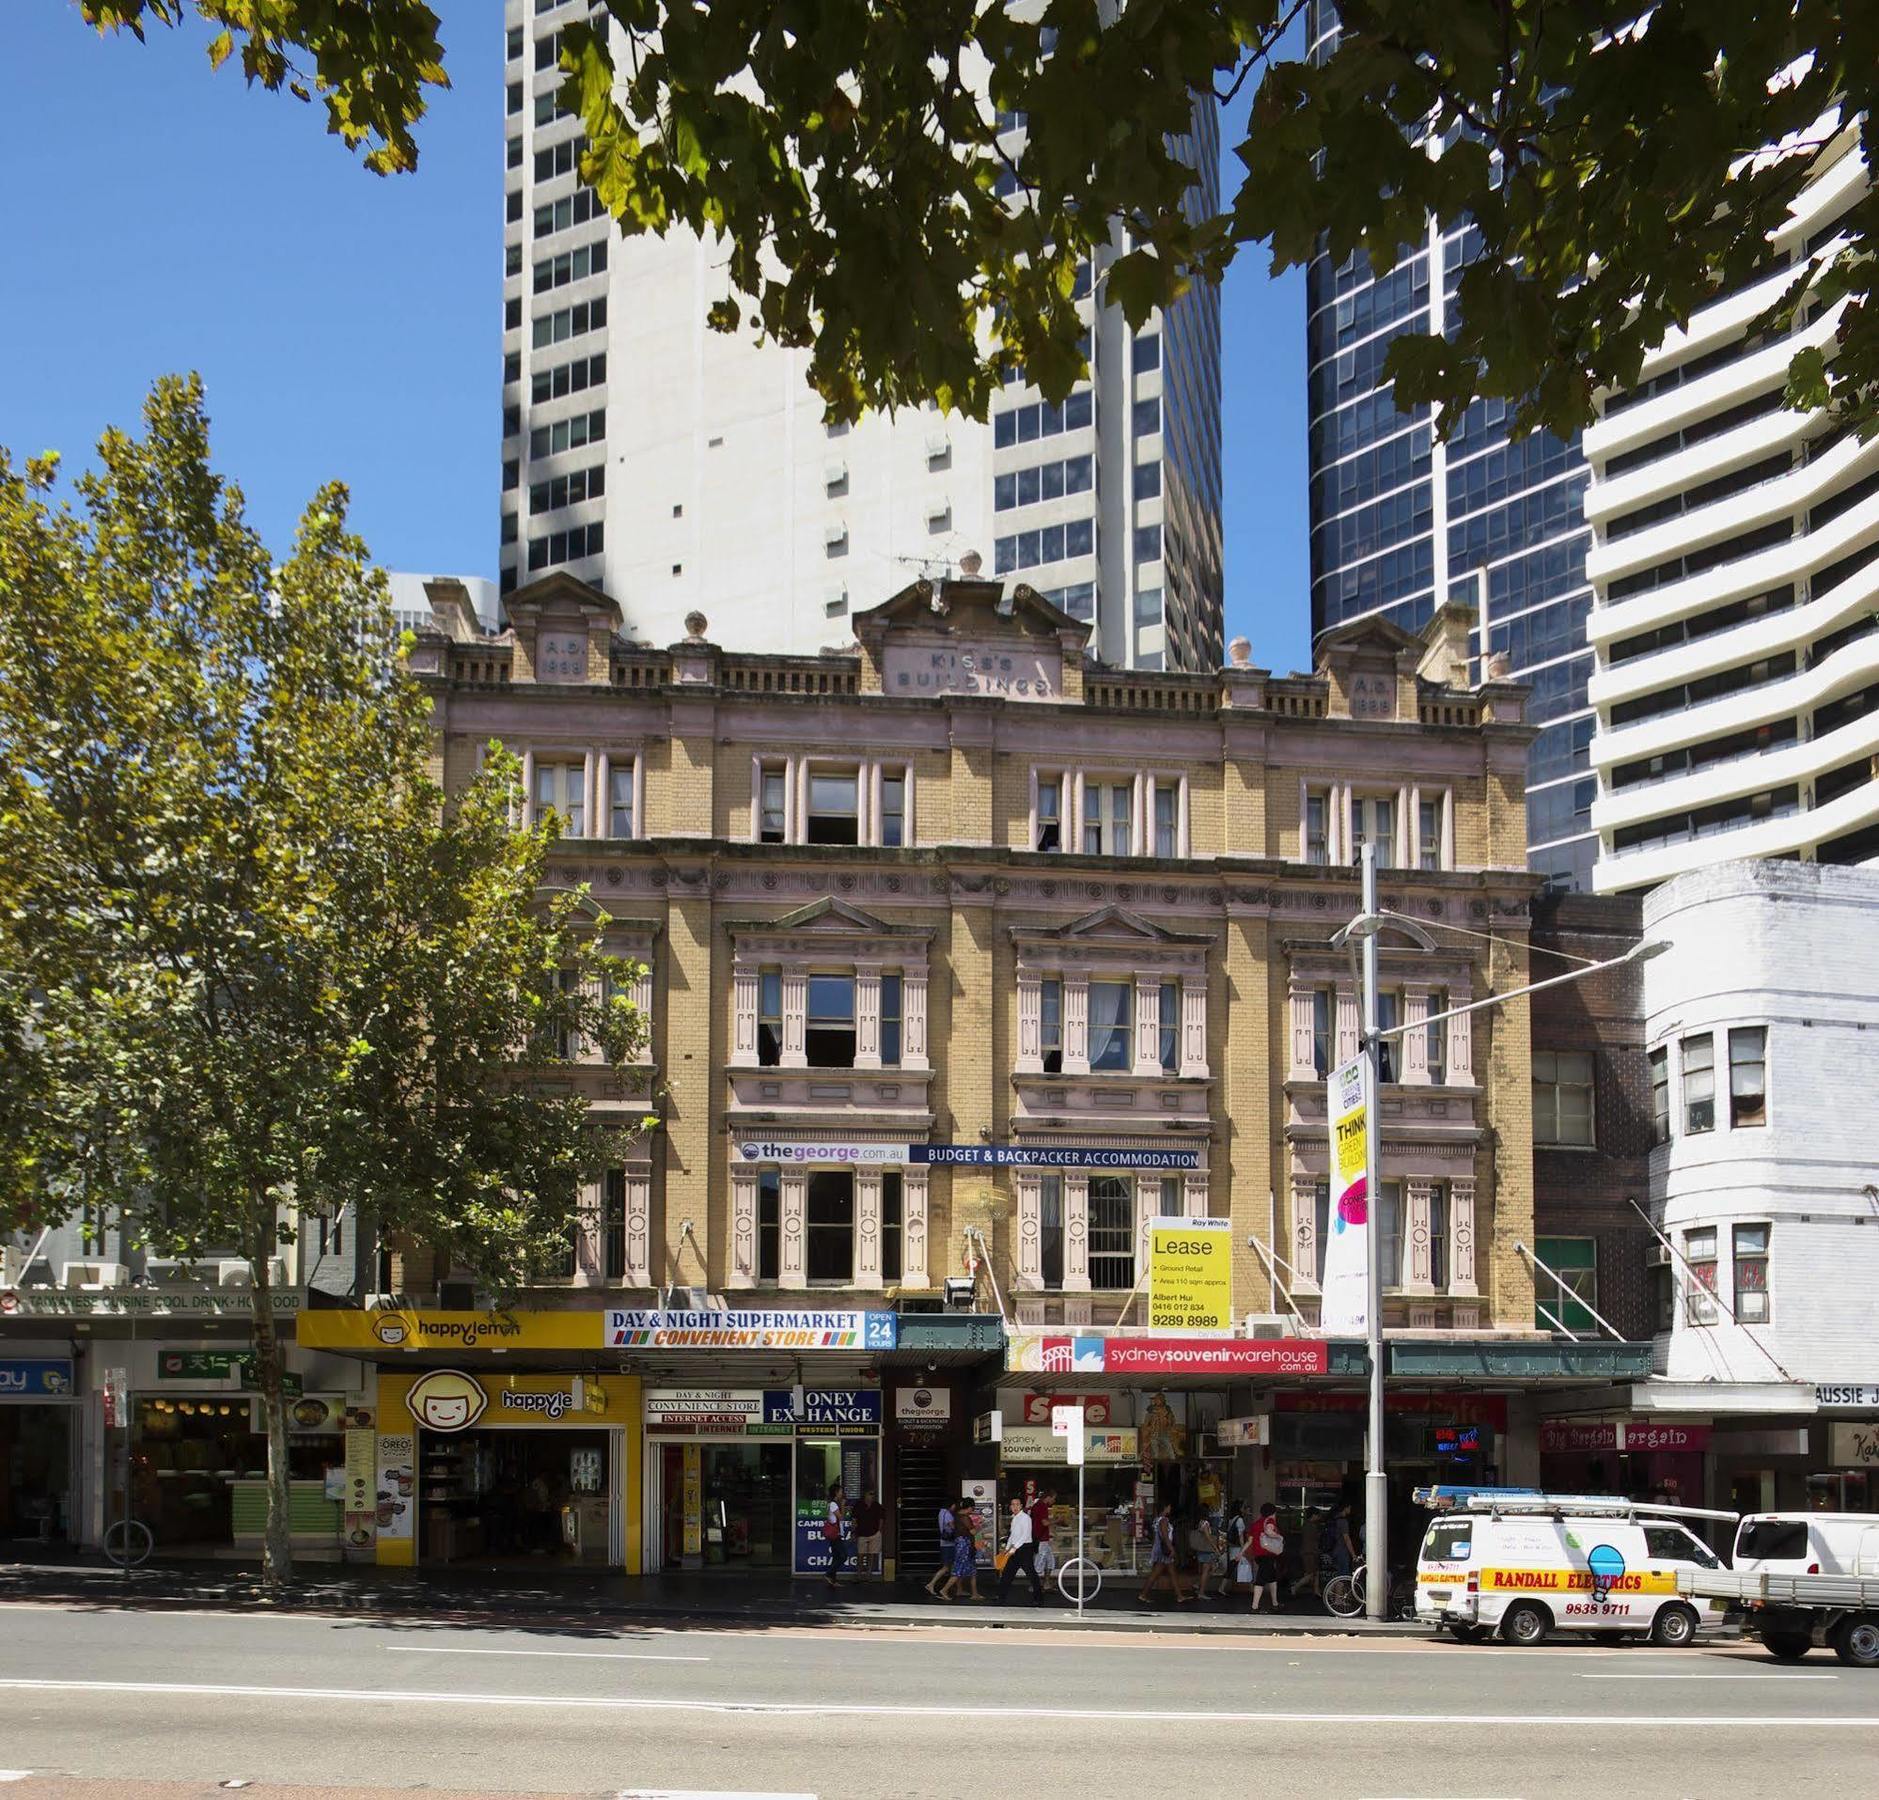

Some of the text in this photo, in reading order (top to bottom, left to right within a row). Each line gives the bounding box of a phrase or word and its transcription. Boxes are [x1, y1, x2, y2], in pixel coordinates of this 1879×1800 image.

[931, 654, 1012, 671] KISS'S
[897, 672, 1049, 696] BUILDINGS
[1336, 1113, 1366, 1141] THINK
[762, 1142, 903, 1161] thegeorge.com.au
[928, 1148, 1199, 1168] BUDGET & BACKPACKER ACCOMMODATION
[1192, 1218, 1229, 1228] Ray White
[1154, 1236, 1213, 1256] Lease
[1159, 1264, 1204, 1273] Ground Retail
[1159, 1277, 1174, 1285] Area
[1176, 1277, 1188, 1285] 110
[1205, 1279, 1227, 1287] approx
[29, 1296, 300, 1308] TAIWANESE CUISINE COOL DRINK HO OOD
[1153, 1293, 1193, 1302] Albert Hui
[1152, 1303, 1172, 1311] 0416
[1173, 1303, 1187, 1311] 012
[612, 1312, 857, 1329] DAY & NIGHT SUPERMARKET
[868, 1313, 892, 1321] OPEN
[1153, 1315, 1218, 1327] 9289 8989
[418, 1320, 520, 1345] happylemn
[868, 1323, 892, 1339] 24
[654, 1330, 815, 1346] CONVENIENT STORE
[867, 1340, 893, 1348] HOURS
[1111, 1348, 1317, 1364] sydneysouvenirwarehouse
[1277, 1362, 1318, 1371] .com.au
[1816, 1387, 1863, 1403] AUSSIE
[502, 1390, 574, 1418] happyle
[648, 1401, 760, 1411] CONVENIENCE STORE
[1027, 1397, 1107, 1423] Se
[663, 1414, 745, 1423] INTERNET ACCESS
[771, 1408, 873, 1422] EXHANGE
[901, 1407, 945, 1417] thegeorge
[799, 1426, 865, 1434] WESTERN UNION
[382, 1440, 409, 1449] OREO
[1003, 1434, 1036, 1444] sydney
[1628, 1428, 1688, 1448] argain
[1003, 1445, 1094, 1454] souvenir warese
[807, 1556, 868, 1566] CHGE
[1494, 1571, 1642, 1591] RANDALL ELECTRICS
[1565, 1602, 1630, 1617] 9838 9711
